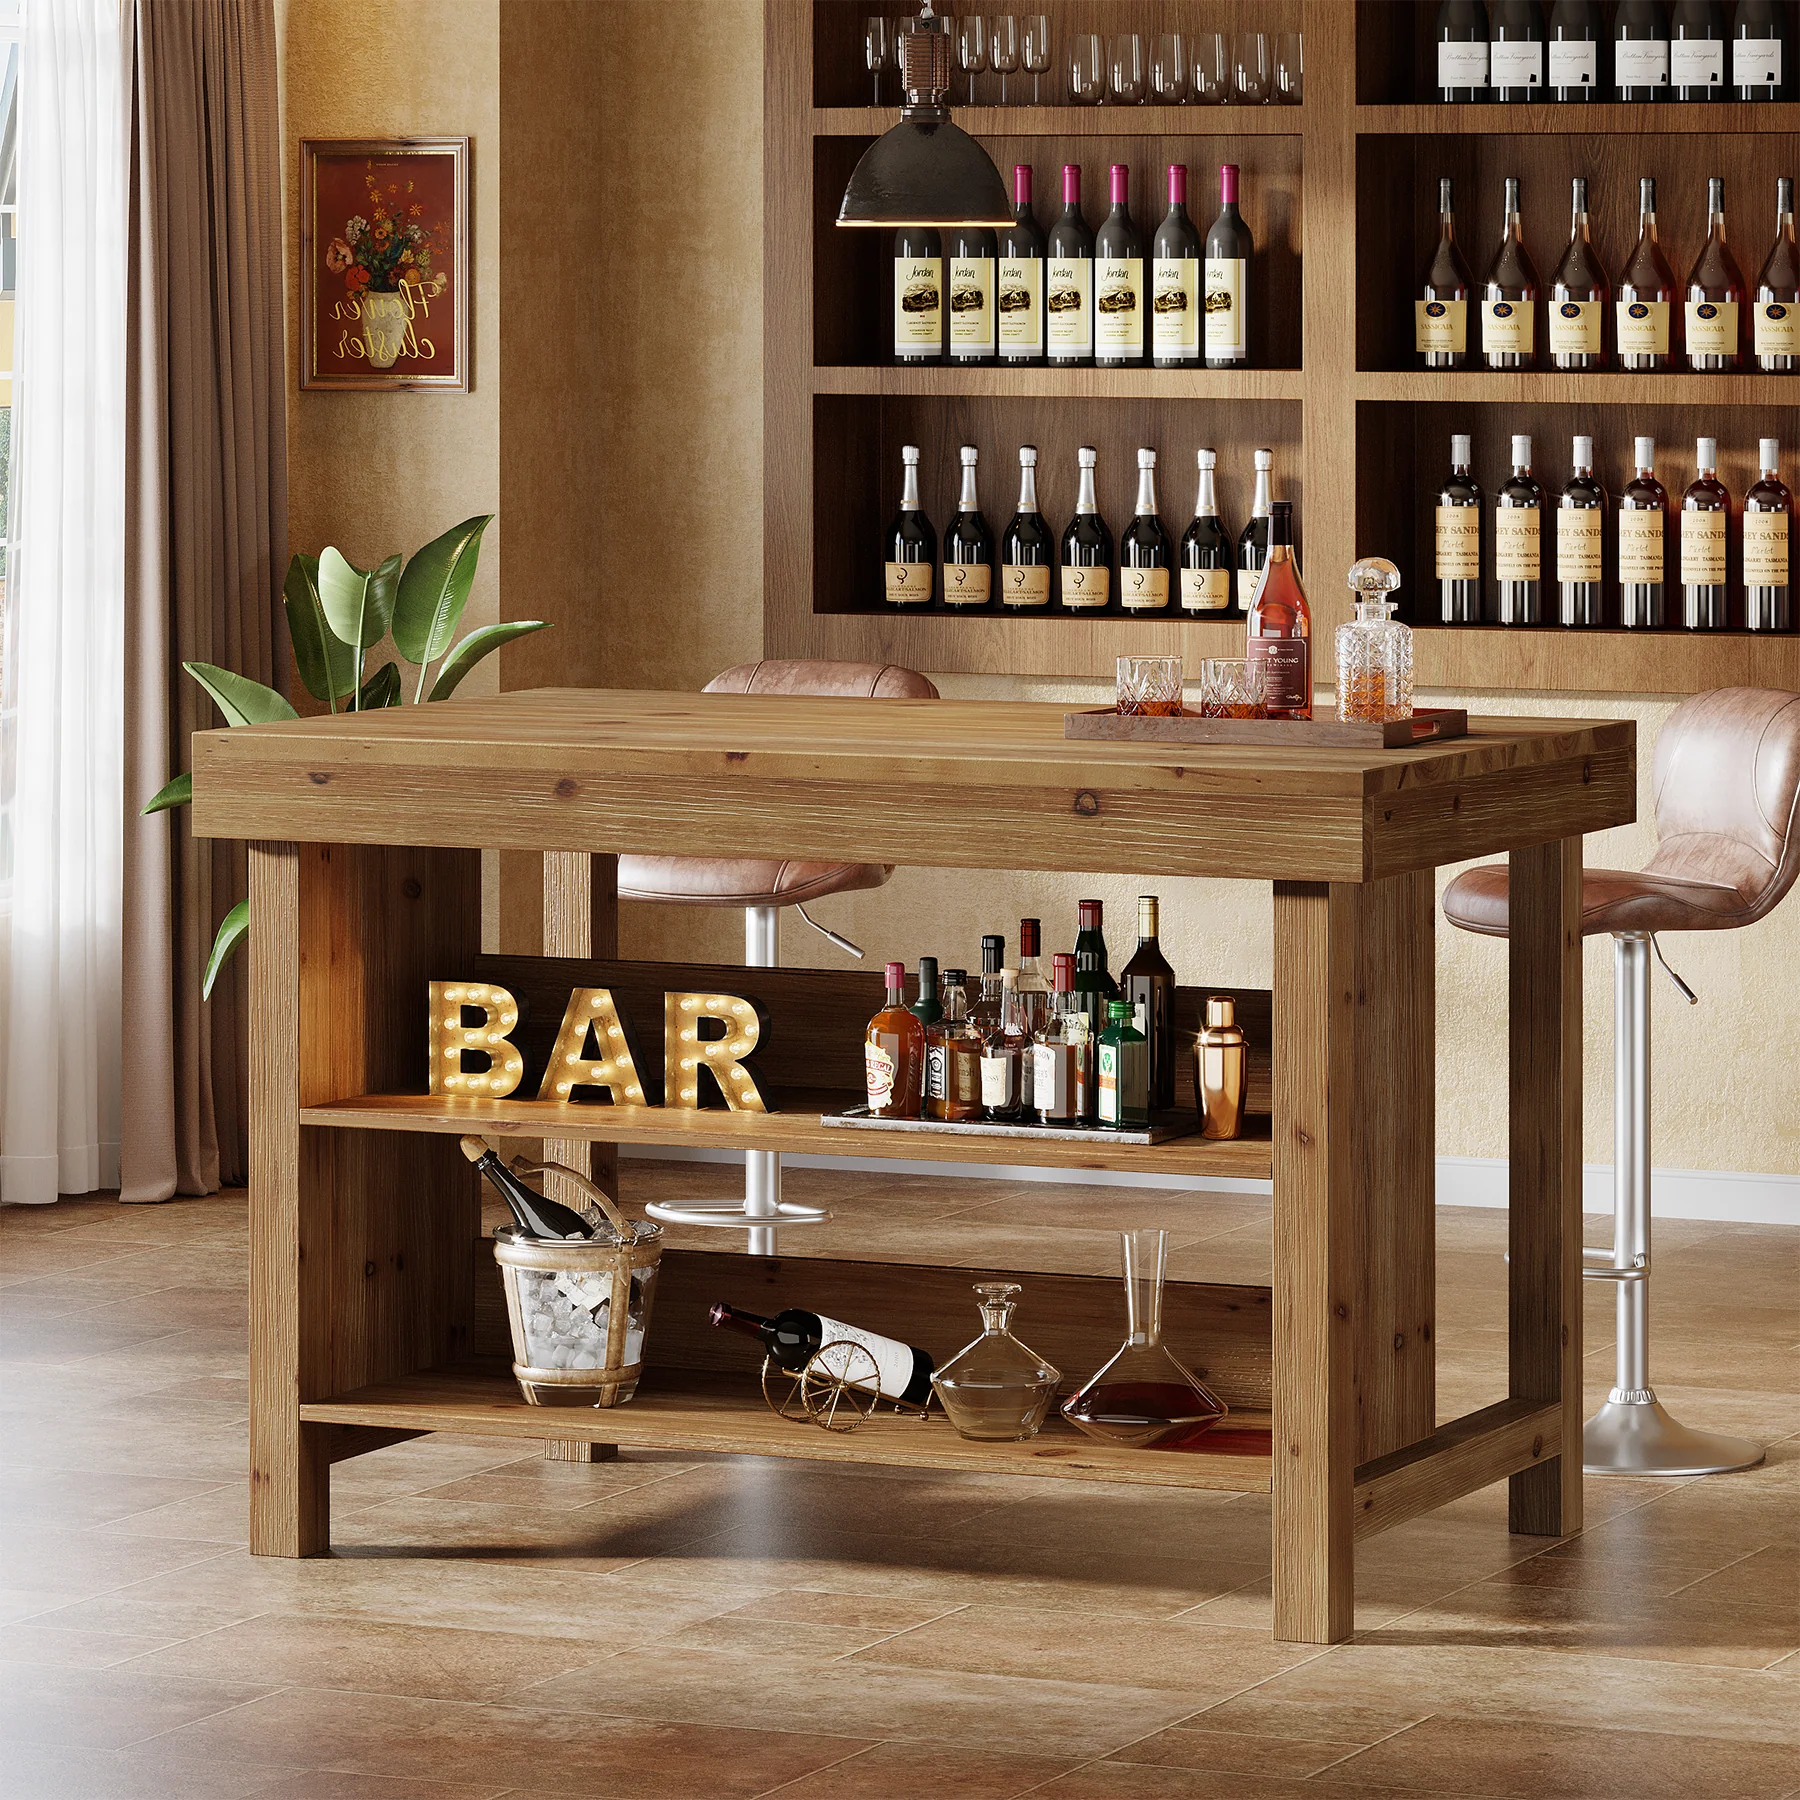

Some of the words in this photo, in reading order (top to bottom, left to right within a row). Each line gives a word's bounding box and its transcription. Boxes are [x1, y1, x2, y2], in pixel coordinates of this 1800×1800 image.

[1467, 51, 1488, 62] Vineyard
[906, 265, 934, 280] Jordan
[953, 265, 976, 281] Jordan
[1001, 266, 1022, 281] Jordan
[1050, 266, 1074, 281] Jordan
[1102, 266, 1129, 281] Jordan
[1157, 266, 1180, 282] Jordan
[1207, 266, 1224, 281] ordan
[428, 980, 776, 1114] BAR
[870, 1060, 891, 1072] REGAL
